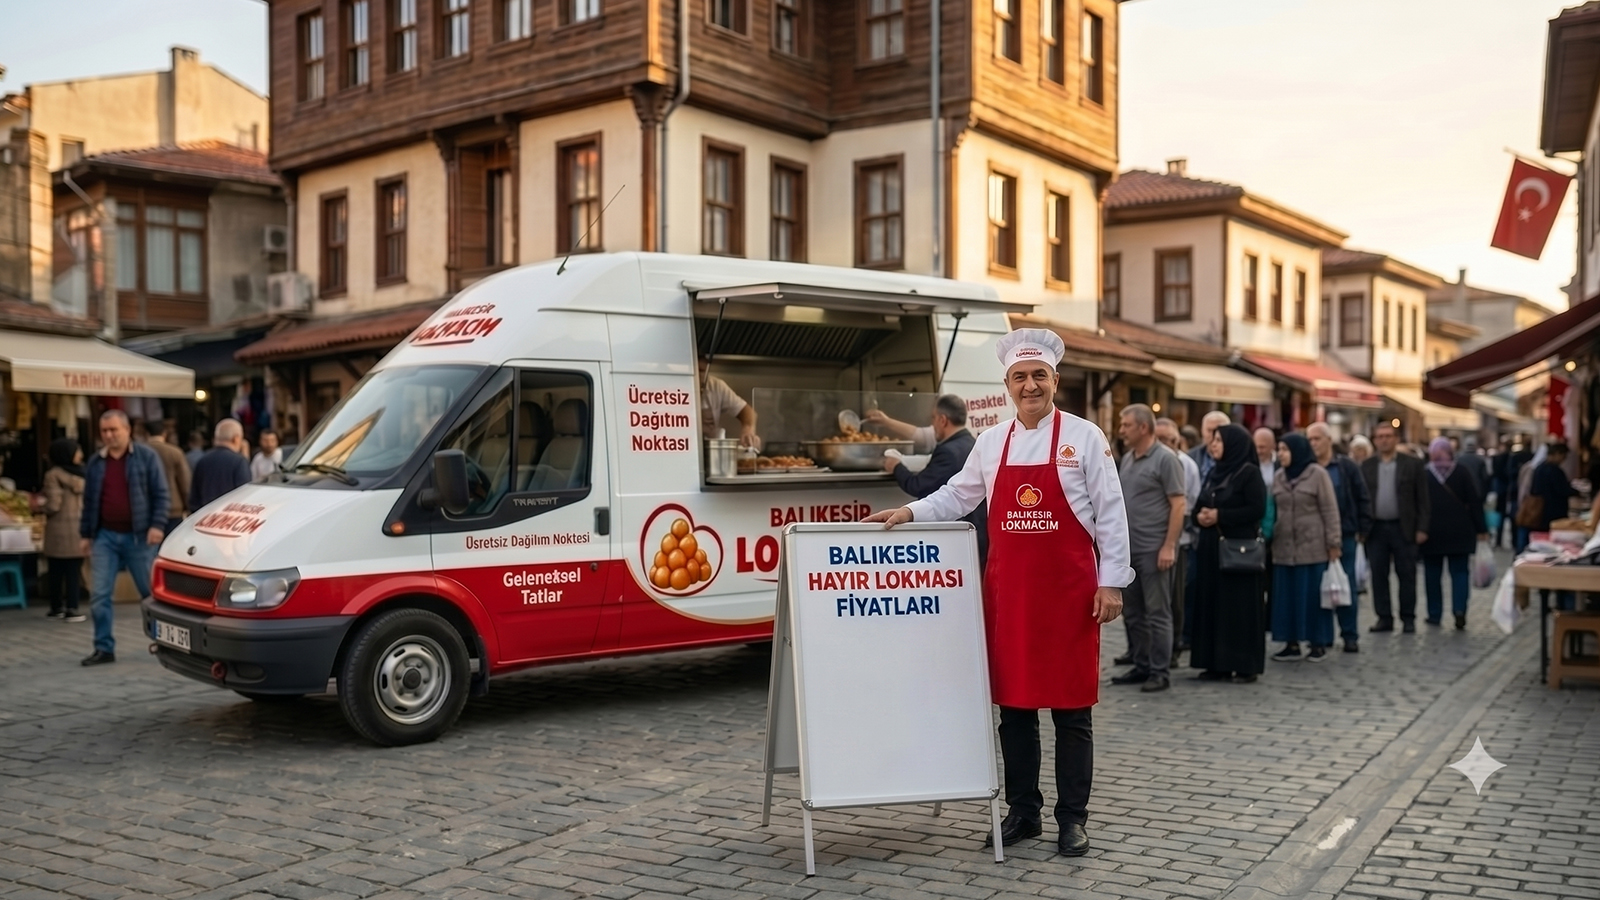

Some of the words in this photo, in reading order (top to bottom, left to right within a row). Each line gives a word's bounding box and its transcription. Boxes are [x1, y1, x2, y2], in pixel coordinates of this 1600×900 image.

[109, 375, 146, 391] KADA
[628, 384, 690, 405] Ücretsiz
[630, 411, 690, 430] Dağıtım
[632, 434, 689, 451] Noktası
[1001, 520, 1059, 530] LOKMACIM
[553, 532, 590, 545] Noktesi
[829, 541, 940, 565] BALIKESİR
[808, 571, 870, 591] HAYIR
[875, 569, 963, 590] LOKMASI
[521, 588, 563, 605] Tatlar
[836, 594, 940, 617] FİYATLARI
